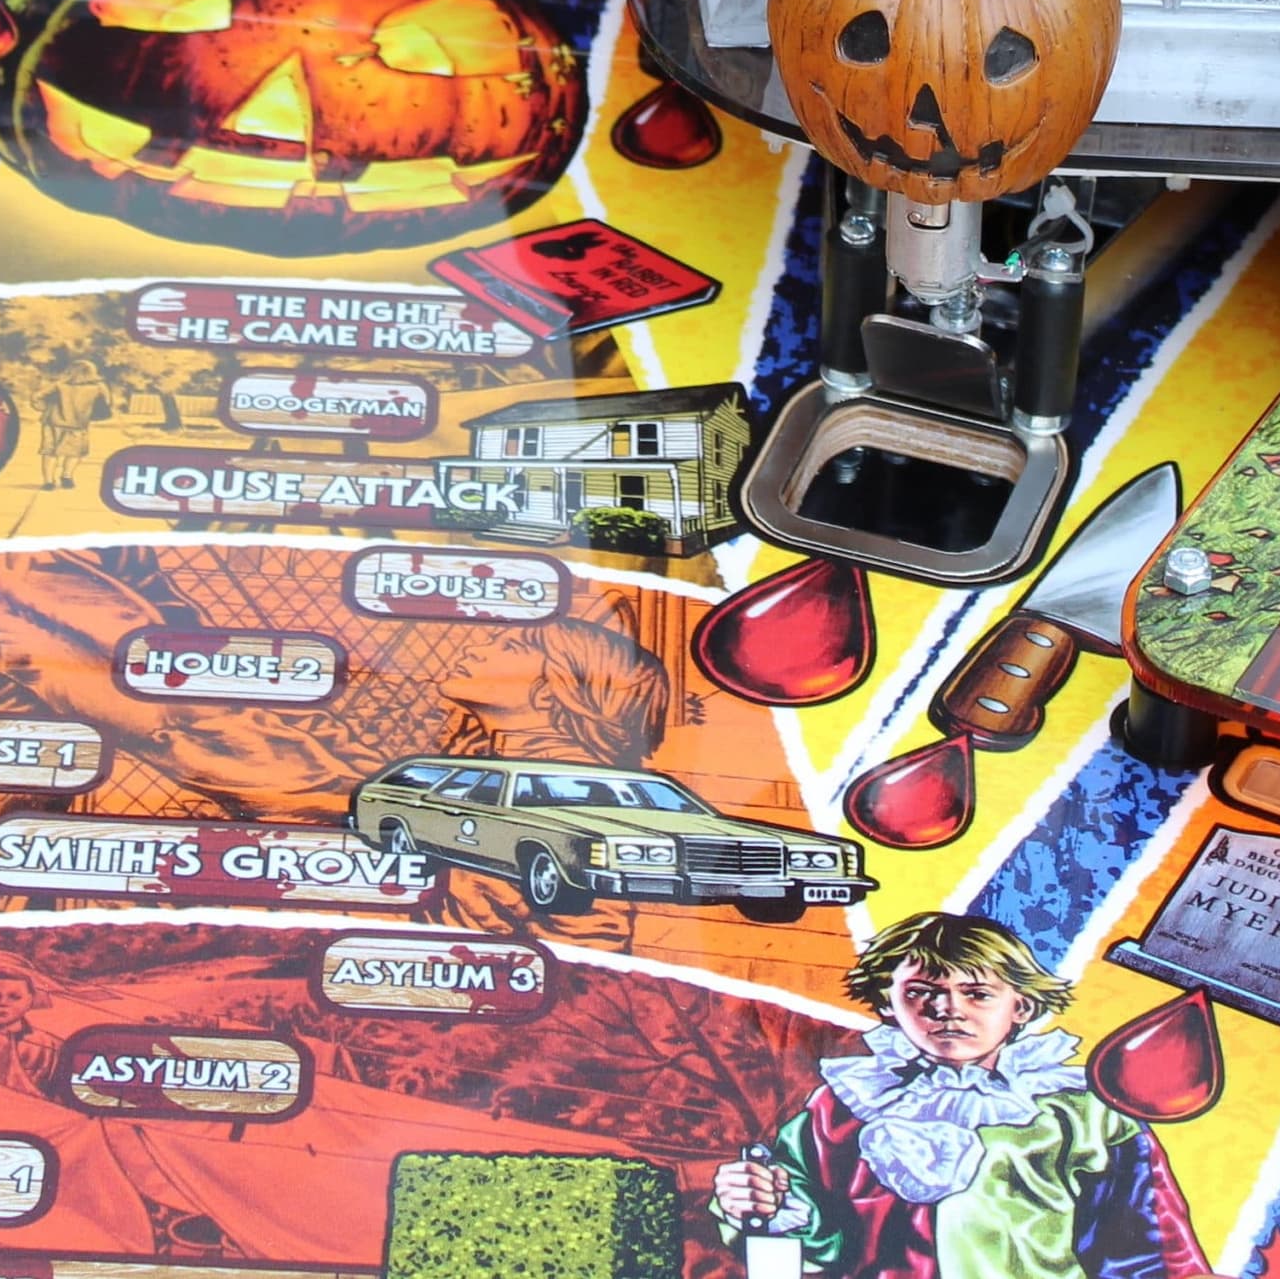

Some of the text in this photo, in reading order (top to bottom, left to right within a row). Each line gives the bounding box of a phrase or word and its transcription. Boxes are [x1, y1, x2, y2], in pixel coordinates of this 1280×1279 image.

[236, 293, 444, 326] THE NIGHT
[179, 316, 495, 355] HE CAME HOME
[234, 391, 423, 420] BOOGEYMAN
[124, 465, 523, 514] HOUSE ATTACK
[374, 572, 544, 603] HOUSE 3
[145, 650, 321, 682] HOUSE 2
[57, 741, 77, 769] 1
[220, 844, 429, 888] GROVE
[331, 959, 538, 994] ASYLUM 3
[81, 1054, 292, 1092] ASYLUM 2
[11, 1164, 35, 1194] 1
